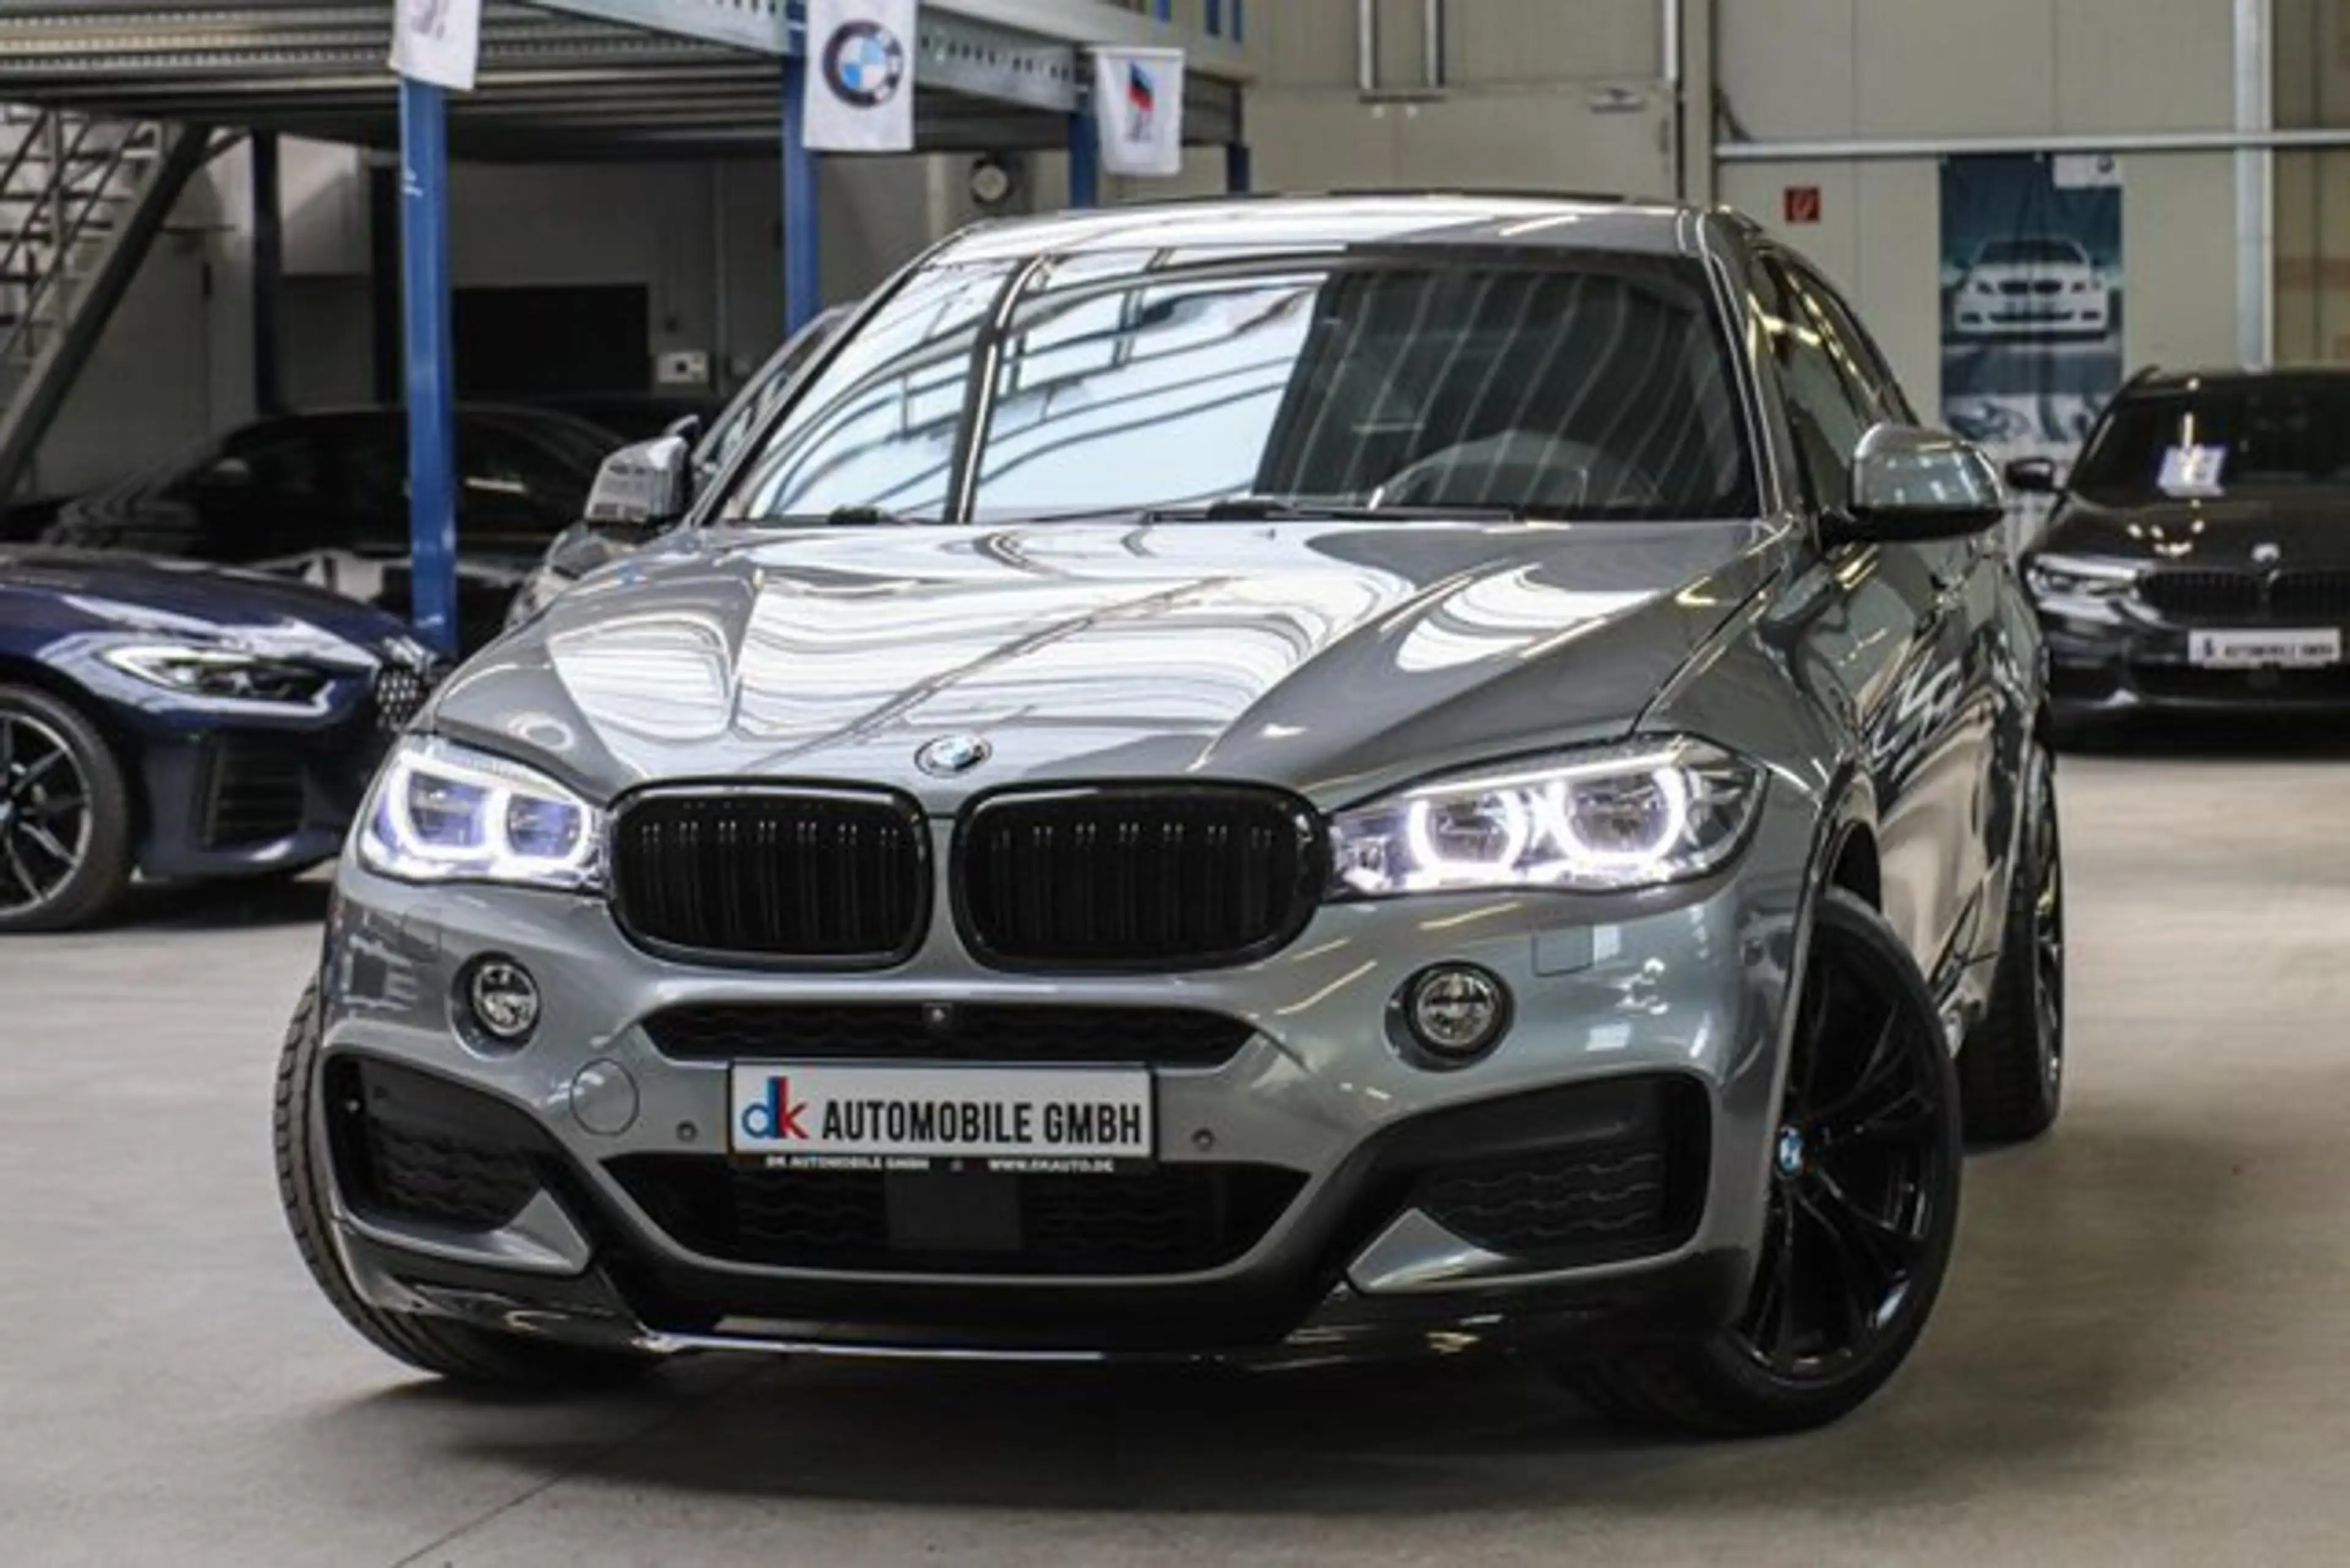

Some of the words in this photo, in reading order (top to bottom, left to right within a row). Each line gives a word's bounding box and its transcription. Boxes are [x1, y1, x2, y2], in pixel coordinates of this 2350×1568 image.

[741, 1075, 808, 1140] dk
[822, 1099, 1032, 1143] AUTOMOBILE
[1044, 1101, 1141, 1144] GMBH
